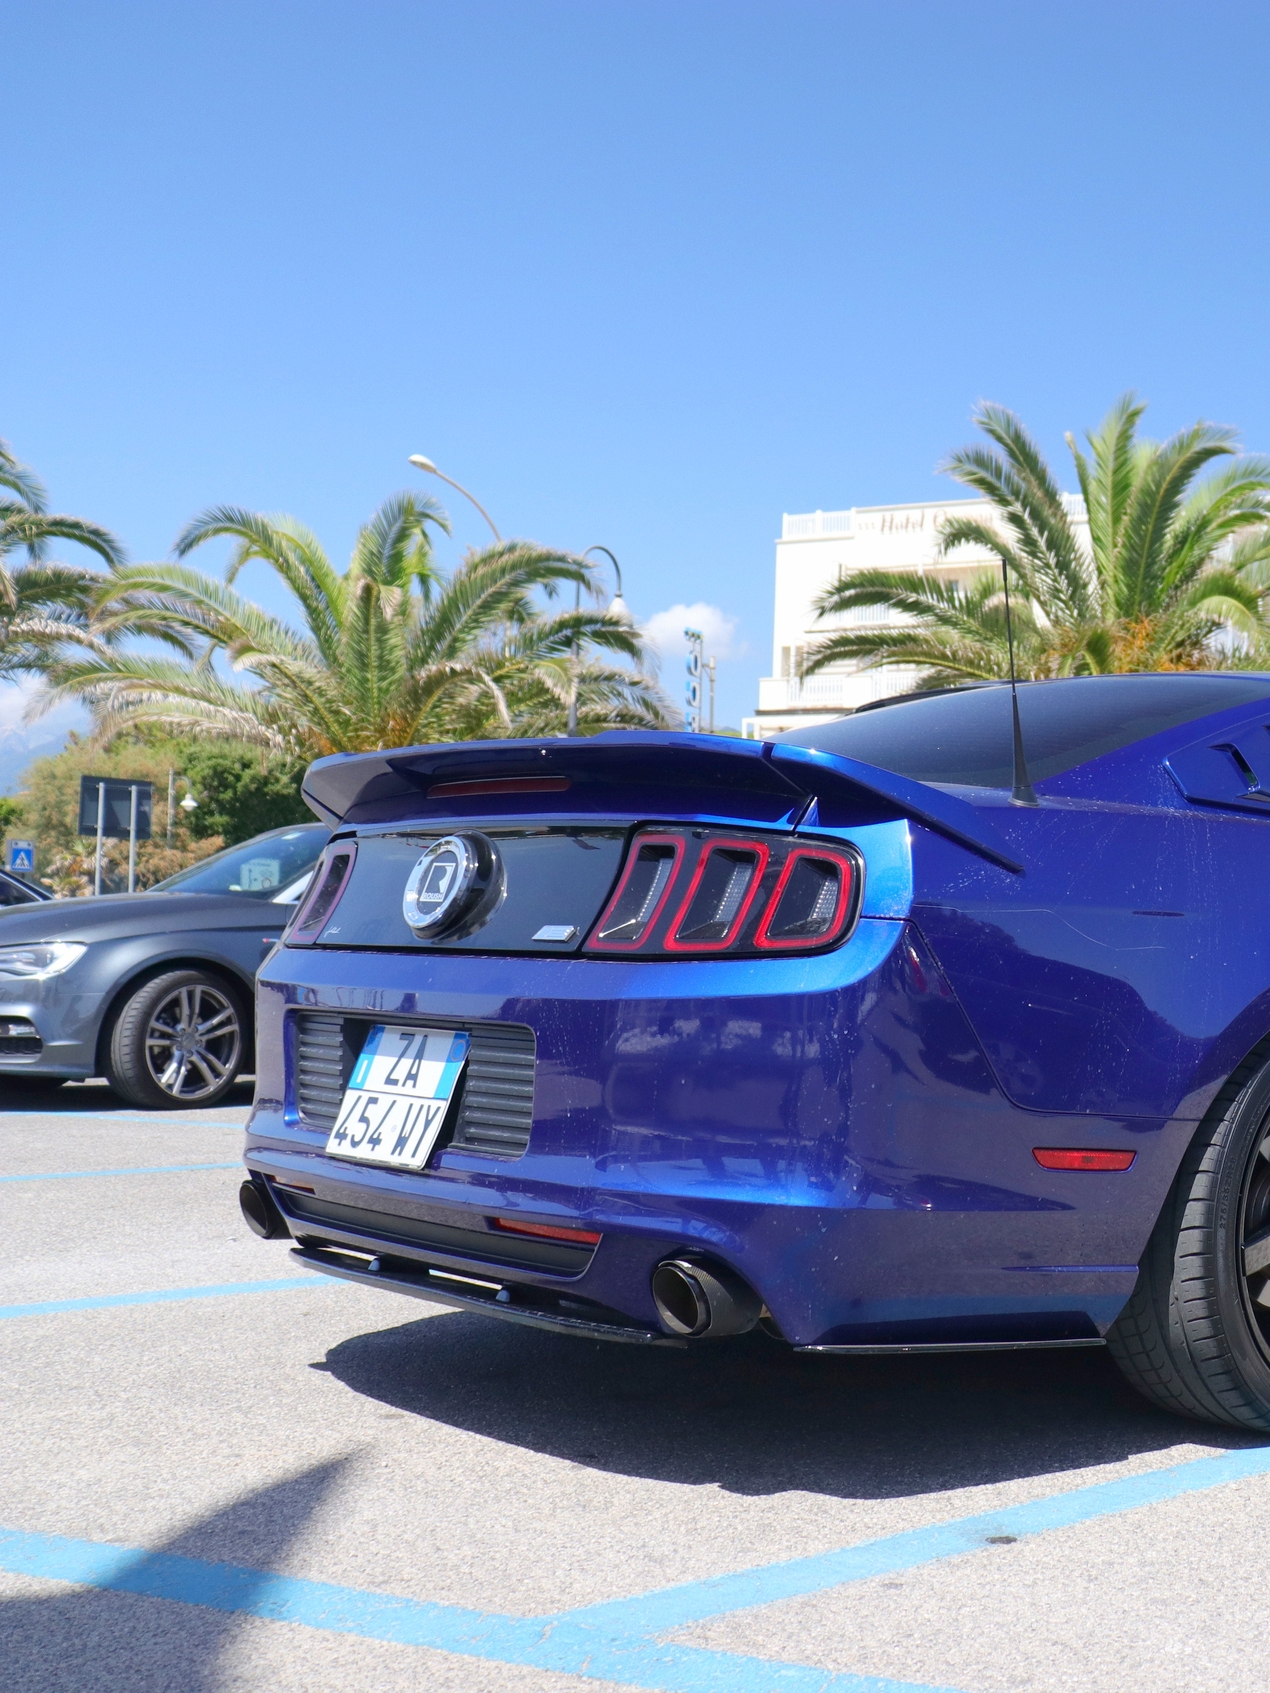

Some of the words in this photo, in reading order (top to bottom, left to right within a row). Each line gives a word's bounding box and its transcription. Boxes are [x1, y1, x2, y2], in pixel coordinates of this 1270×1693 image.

[880, 509, 925, 535] Hotel
[421, 892, 445, 900] ROUSH
[383, 1032, 429, 1089] ZA
[332, 1094, 398, 1152] 454
[389, 1102, 442, 1159] WY
